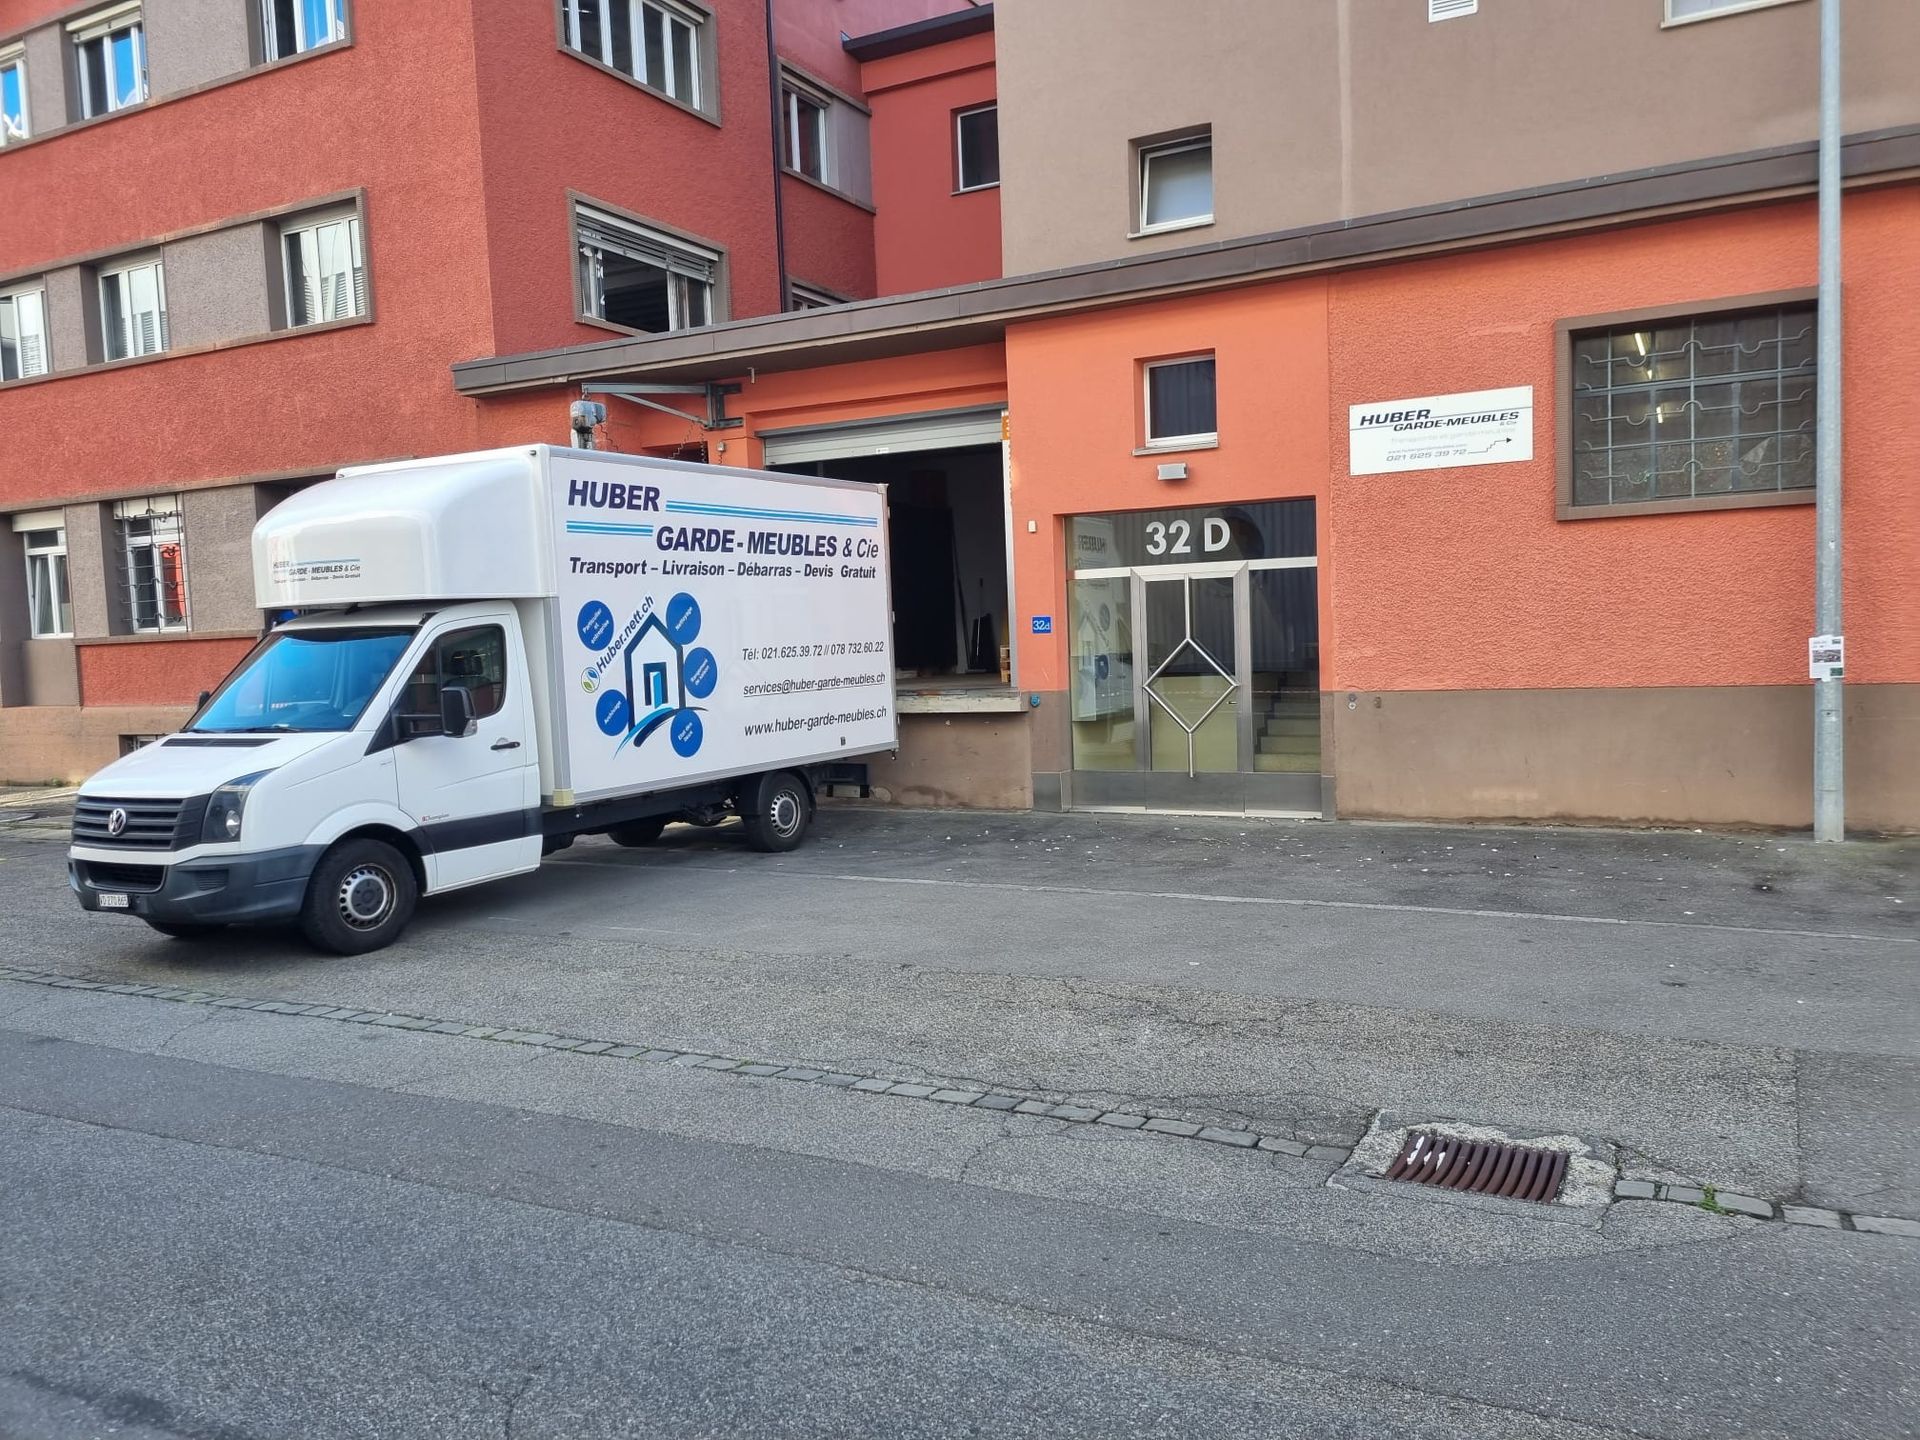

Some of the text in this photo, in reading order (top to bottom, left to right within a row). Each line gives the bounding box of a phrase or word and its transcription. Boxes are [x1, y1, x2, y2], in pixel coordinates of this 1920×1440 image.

[1360, 409, 1431, 426] HUBER
[1393, 411, 1520, 432] GARDE-MEUBLES
[568, 479, 660, 512] HUBER
[656, 526, 736, 553] GARDE
[747, 530, 837, 557] MEUBLES
[843, 537, 852, 558] &
[857, 538, 879, 559] Cie
[1145, 519, 1191, 556] 32
[1203, 517, 1231, 552] D
[311, 564, 343, 574] MEUBLES
[569, 556, 647, 578] Transport
[662, 559, 725, 576] Livraison
[737, 561, 792, 577] Débarras
[804, 563, 834, 578] Devis
[840, 564, 876, 579] Gratuit
[596, 595, 654, 674] Huber.nett.ch
[1033, 619, 1050, 630] 32d
[761, 644, 822, 660] 021.625.39.72
[831, 643, 846, 656] 078
[848, 641, 885, 654] 732.60.22
[743, 672, 886, 697] services@huber-garde-meubles.ch
[744, 705, 887, 737] www.huber-garde-meubles.ch
